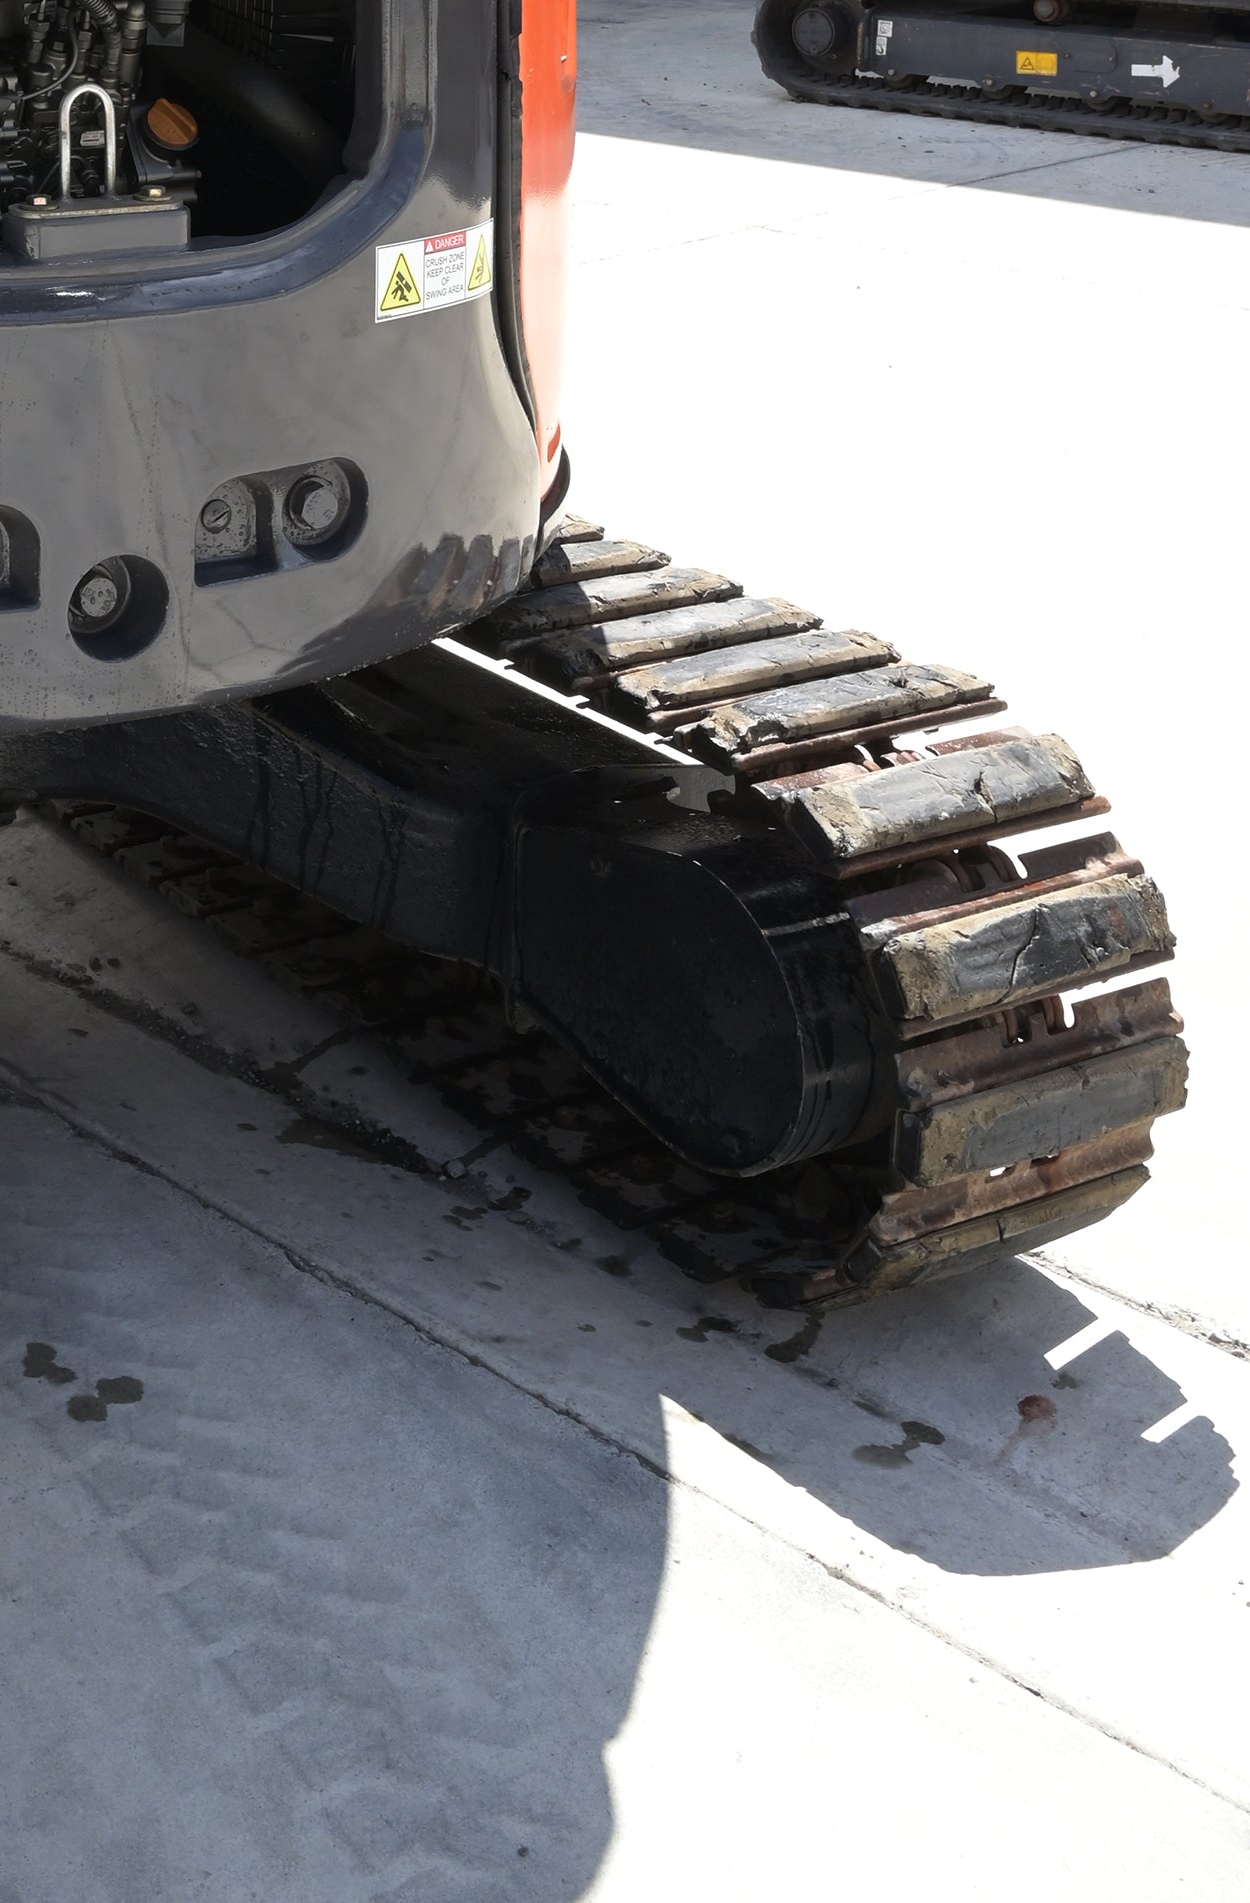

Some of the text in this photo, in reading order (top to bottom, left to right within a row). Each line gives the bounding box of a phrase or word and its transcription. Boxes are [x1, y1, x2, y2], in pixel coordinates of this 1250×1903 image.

[435, 235, 464, 249] DANGER
[426, 251, 464, 268] CRUSH ZONE
[426, 262, 464, 278] KEEP CLEAR
[441, 276, 450, 286] OF
[426, 283, 464, 300] SWING AREA
